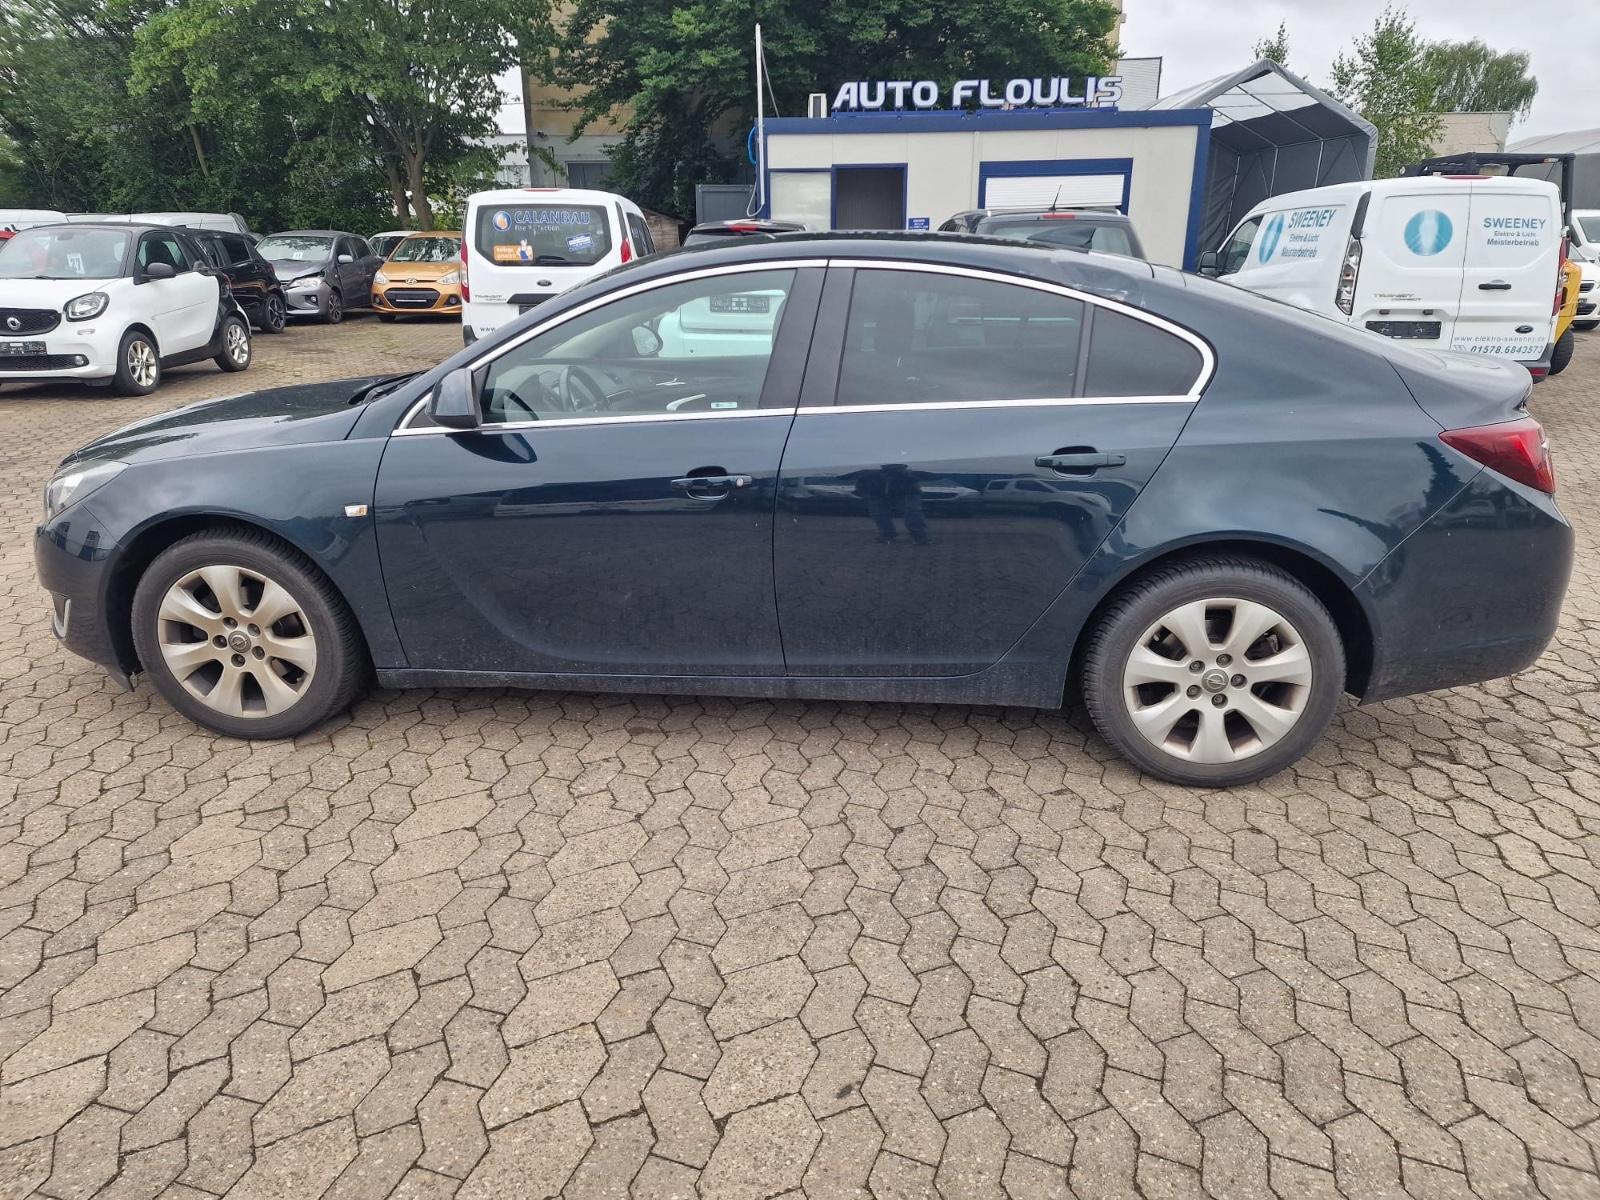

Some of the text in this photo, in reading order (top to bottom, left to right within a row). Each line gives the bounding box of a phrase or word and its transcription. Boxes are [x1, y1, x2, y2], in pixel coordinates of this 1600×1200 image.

[832, 76, 1124, 109] AUTO FLOULIS
[515, 210, 591, 224] CALANBAU
[1288, 209, 1337, 229] SWEENEY
[1483, 217, 1546, 229] SWEENEY
[1487, 238, 1540, 247] Meisterbetrieb
